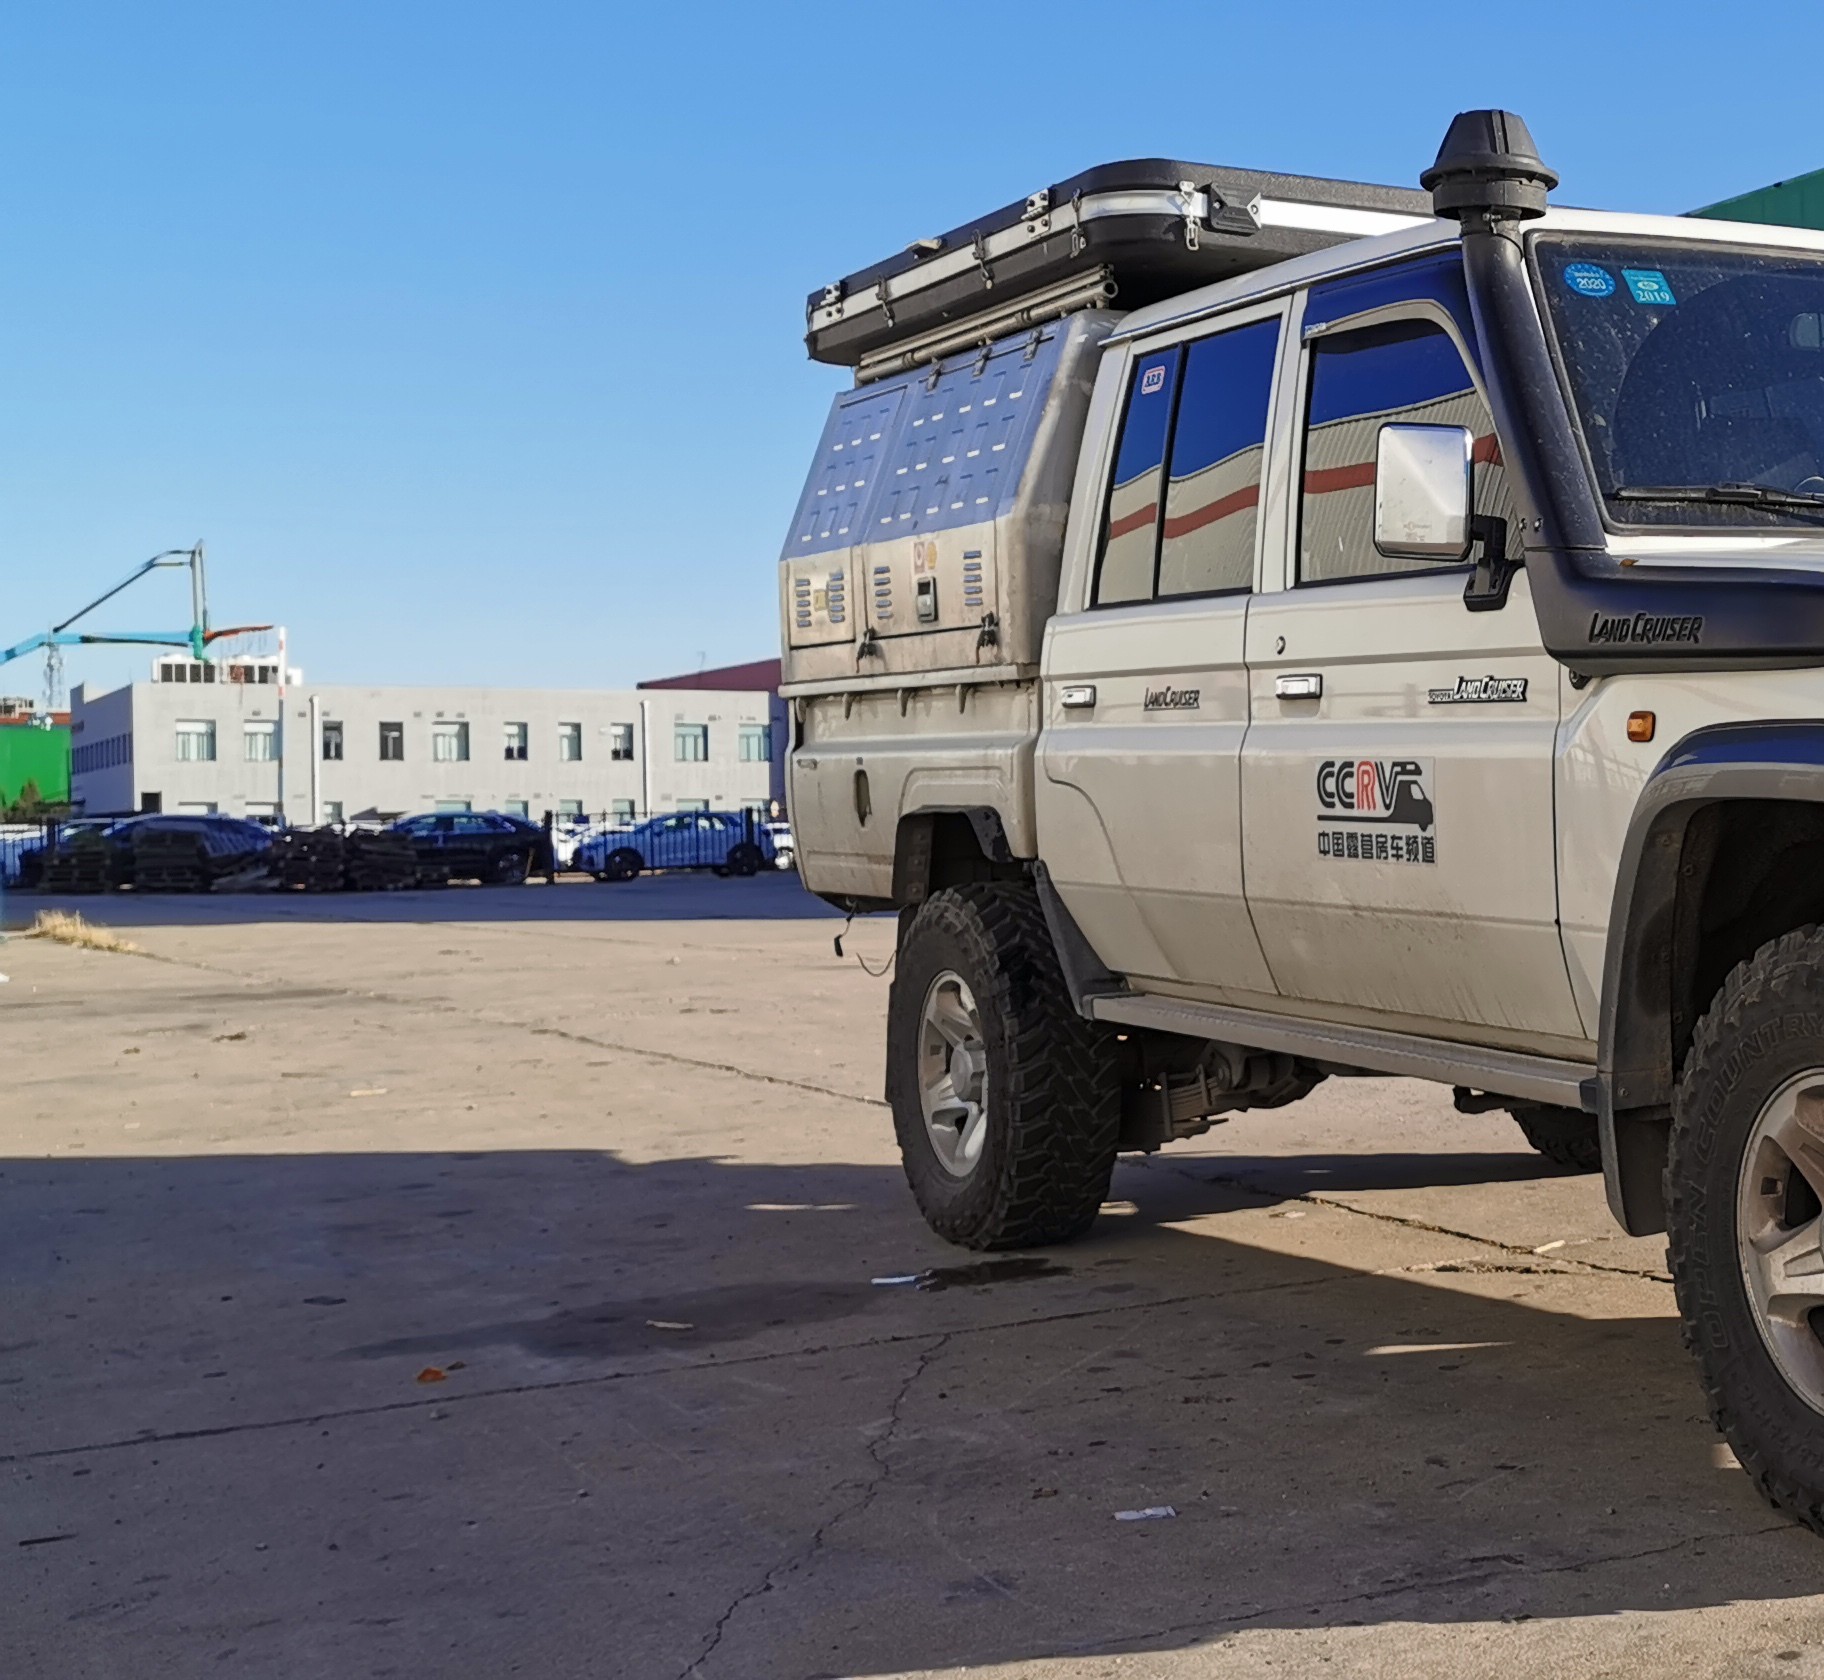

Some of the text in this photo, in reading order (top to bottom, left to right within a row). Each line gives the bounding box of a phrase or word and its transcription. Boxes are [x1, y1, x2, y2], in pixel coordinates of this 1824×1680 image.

[1577, 278, 1607, 290] 2020
[1636, 290, 1671, 303] 2019
[1317, 760, 1402, 811] CCRV
[1317, 831, 1436, 864] 中国露营房车频道
